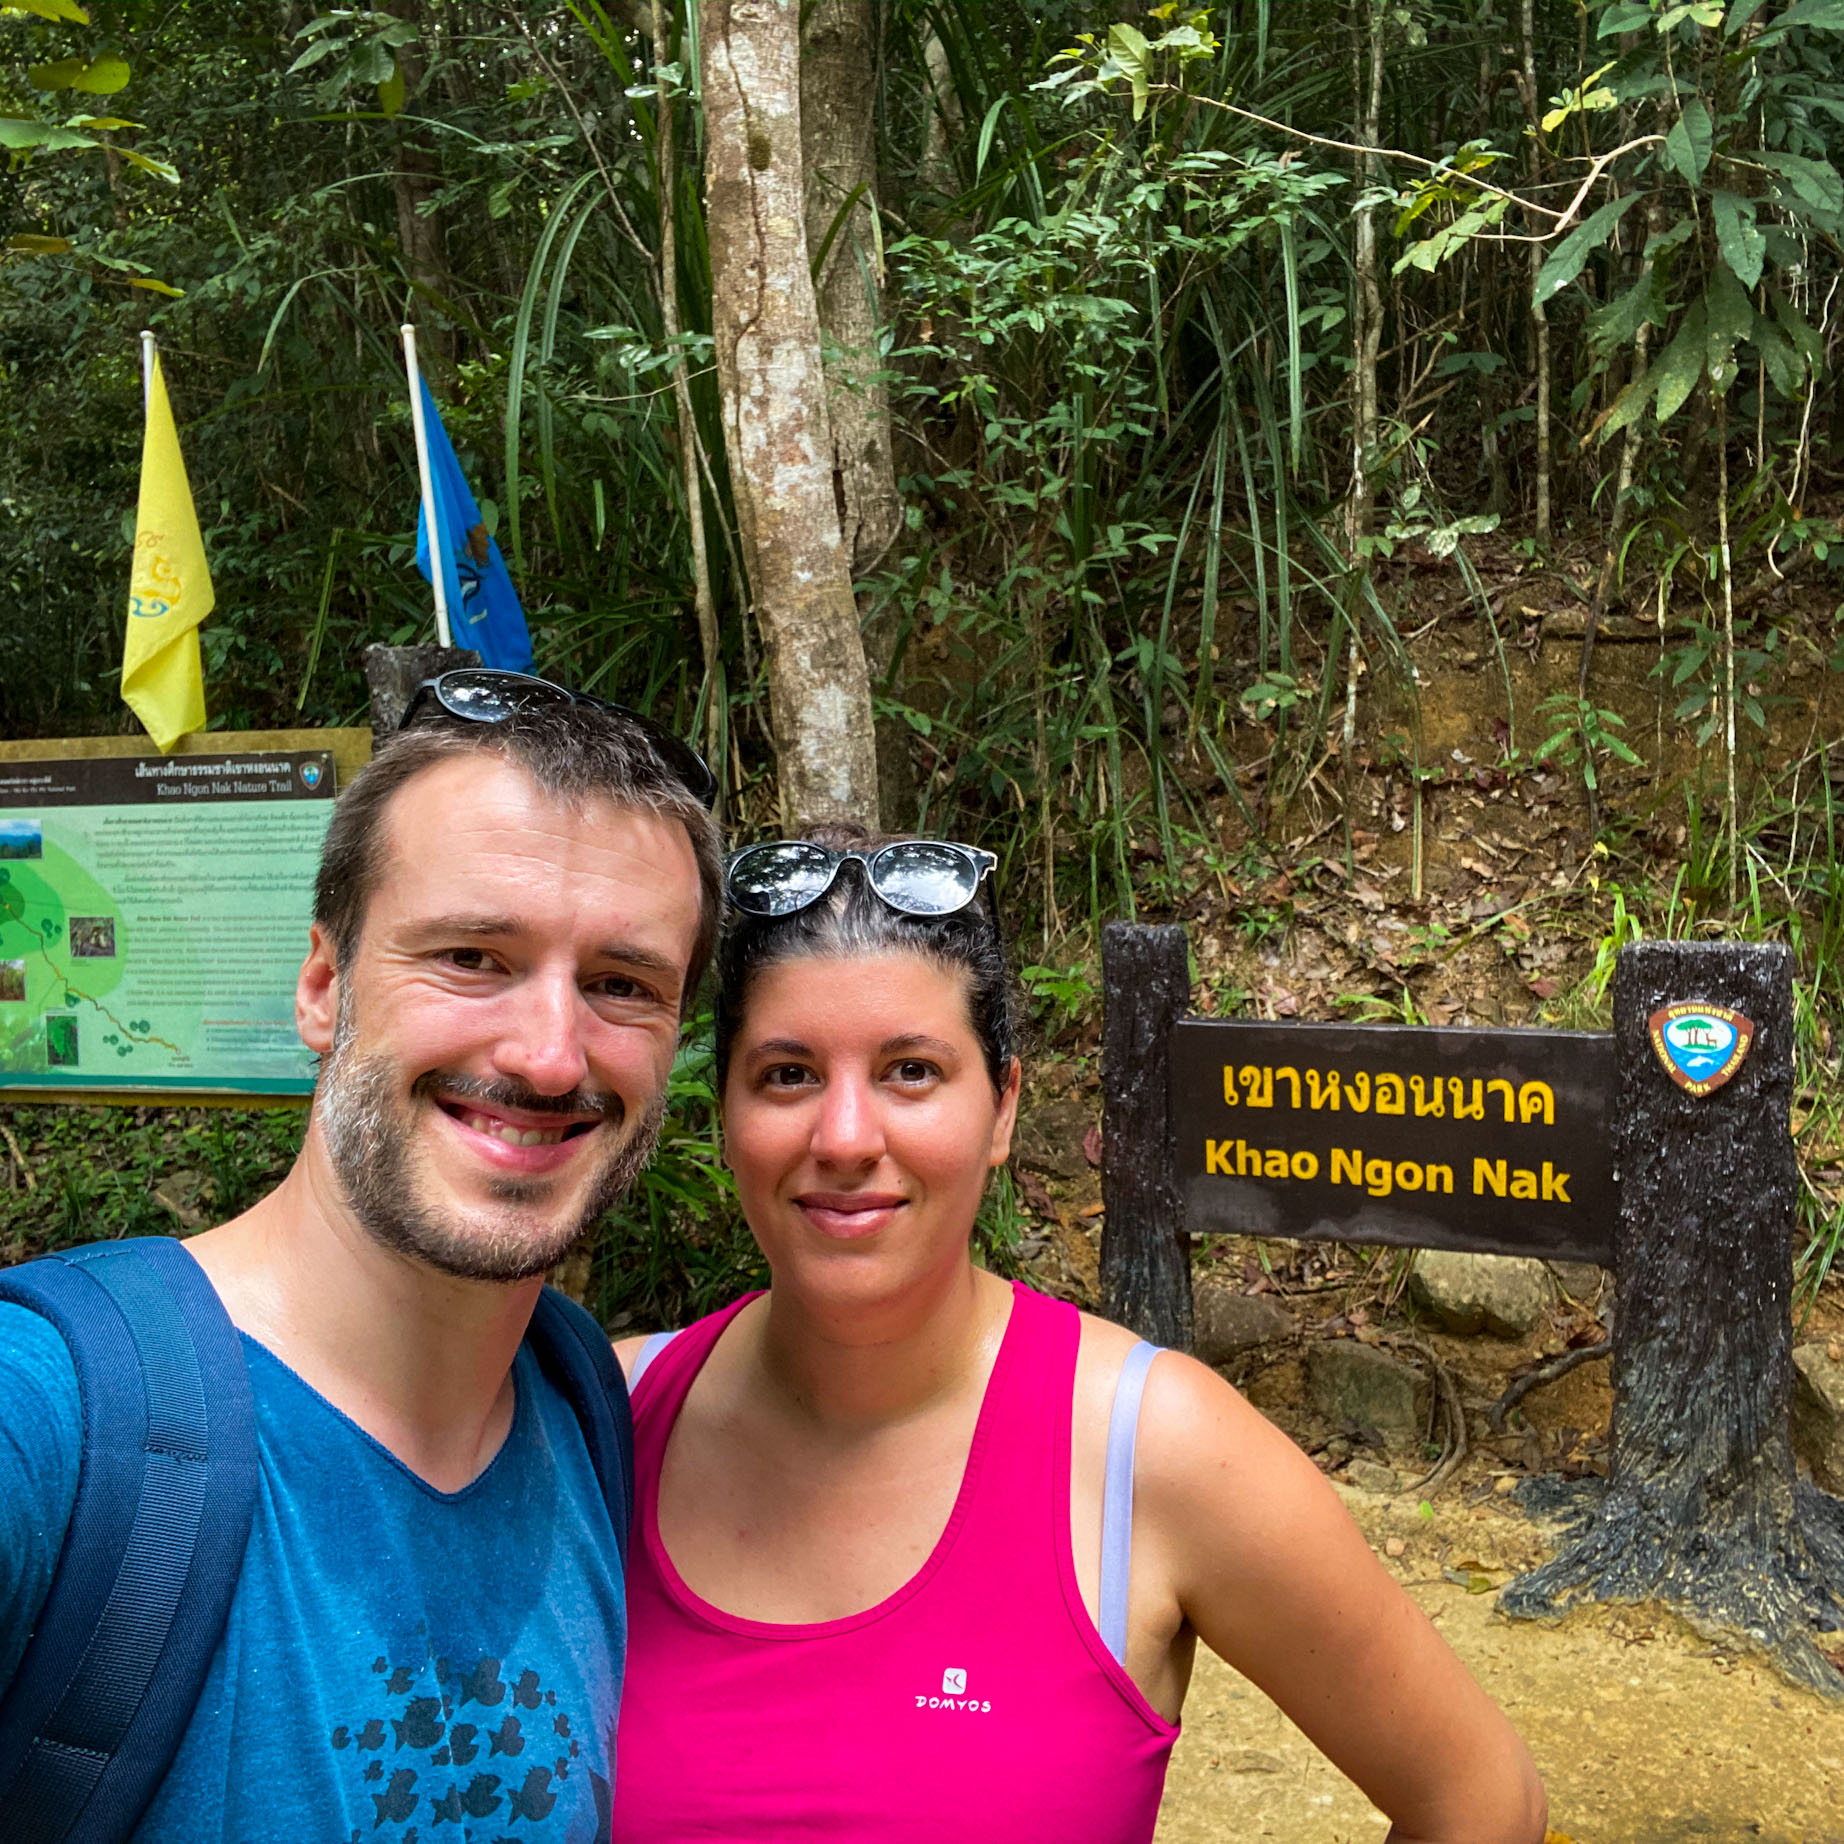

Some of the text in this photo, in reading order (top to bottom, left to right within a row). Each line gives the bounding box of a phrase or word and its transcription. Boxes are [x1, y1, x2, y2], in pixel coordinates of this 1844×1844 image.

[156, 779, 293, 796] Khao Ngon Nak Nature Trail
[1652, 1030, 1677, 1074] NATIONAL
[1721, 1034, 1749, 1077] THAILAND
[1223, 1065, 1555, 1125] เขาหงอนนาค
[1684, 1081, 1712, 1093] PARK
[1205, 1139, 1572, 1203] Khao Ngon Nak
[915, 1696, 992, 1713] DOMYOS
